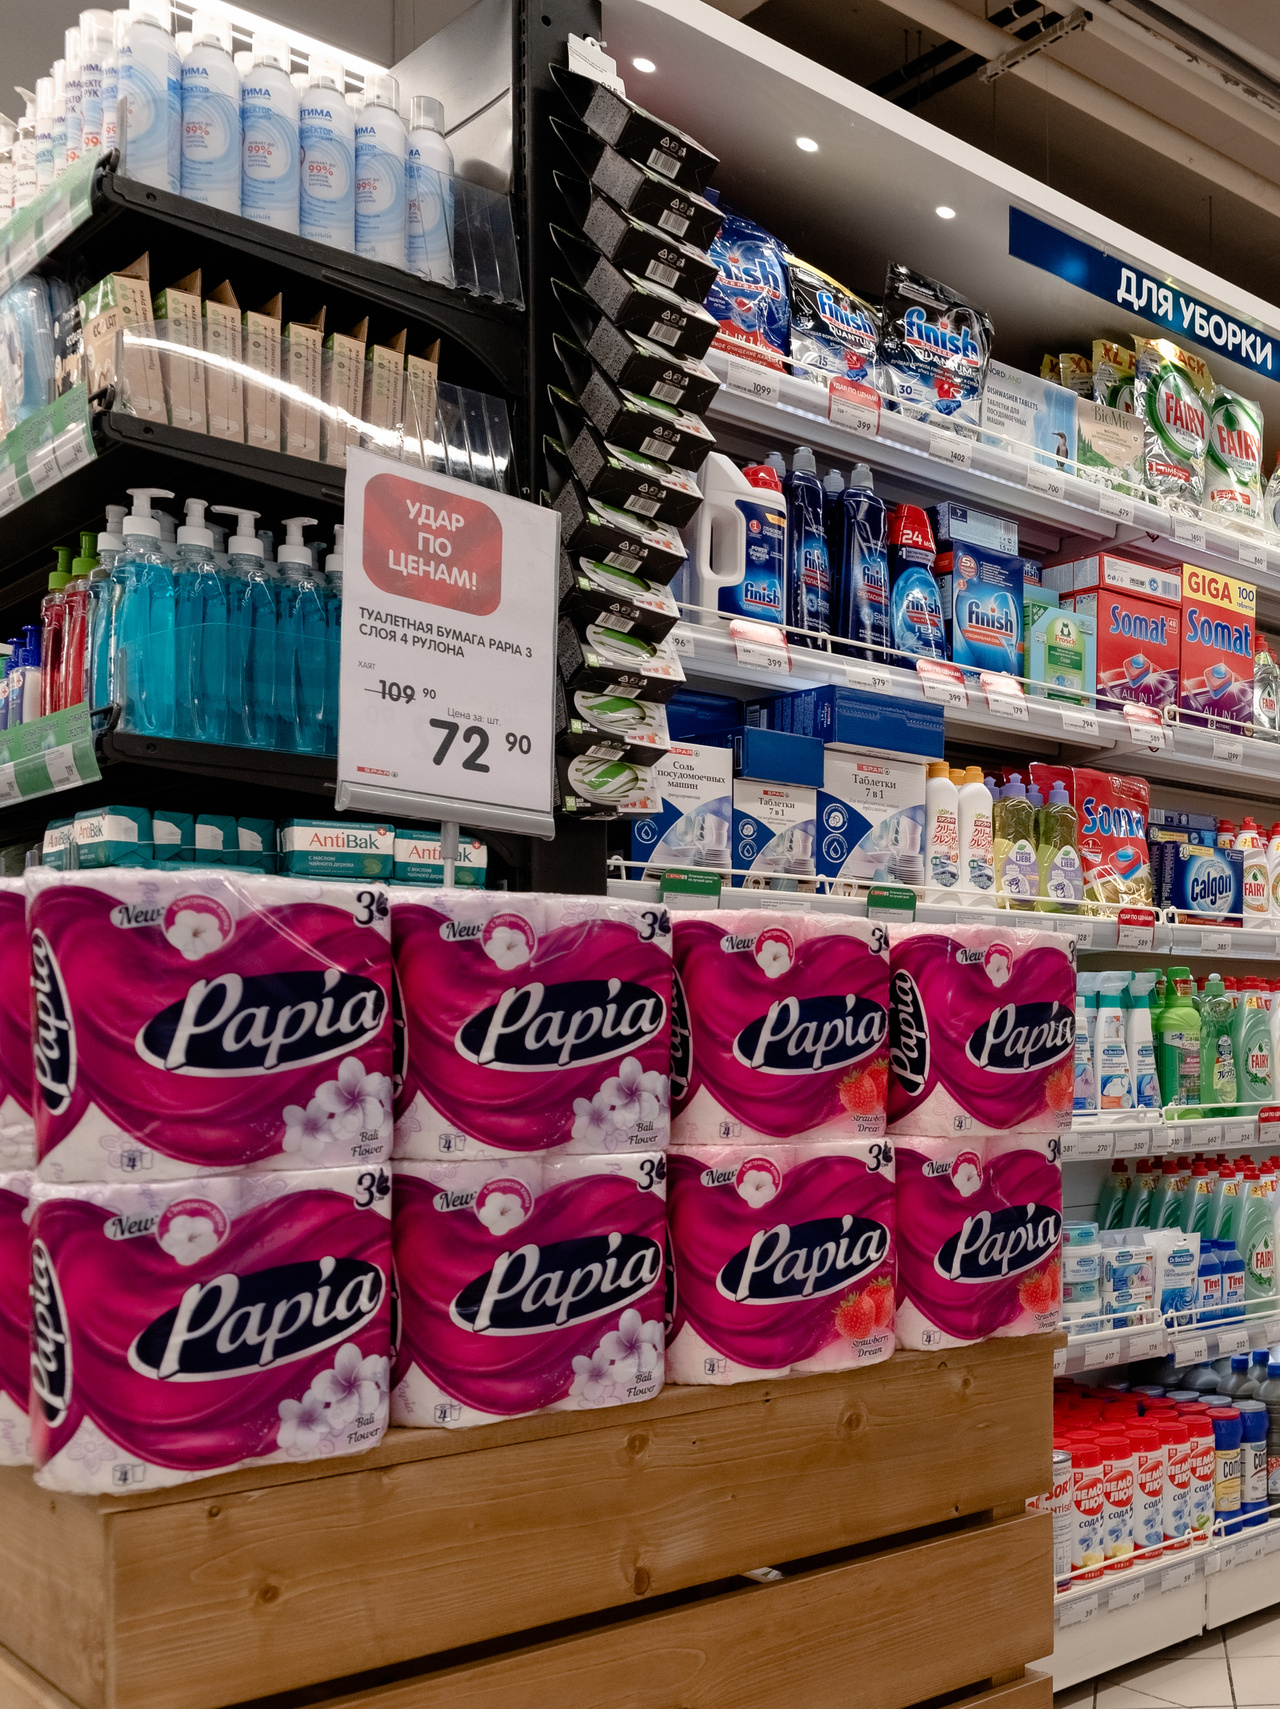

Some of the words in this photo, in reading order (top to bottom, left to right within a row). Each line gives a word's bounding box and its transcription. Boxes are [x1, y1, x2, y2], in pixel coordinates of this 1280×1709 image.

[308, 164, 334, 176] 99%
[816, 289, 875, 336] finish
[1117, 268, 1173, 321] ДЛЯ
[1179, 297, 1273, 371] УБОРКИ
[904, 305, 980, 366] finish
[753, 382, 772, 396] 1099
[832, 381, 847, 393] УДАР
[847, 386, 857, 395] ПО
[898, 383, 913, 396] 30
[986, 385, 1021, 405] DISHWASHER
[1021, 396, 1039, 411] TABLETS
[1092, 404, 1132, 432] BioMio
[1165, 391, 1206, 440] FAIRY
[856, 420, 871, 432] 399
[950, 450, 966, 463] 1402
[1048, 484, 1059, 494] 700
[406, 499, 465, 532] УДАР
[1118, 508, 1129, 518] 479
[417, 532, 451, 557] ПО
[902, 529, 923, 546] 24
[388, 549, 477, 591] ЦЕНАМ!
[804, 549, 829, 577] finish
[862, 565, 888, 589] finish
[744, 580, 781, 606] finish
[1188, 571, 1233, 604] GIGA
[1238, 586, 1255, 603] 100
[967, 600, 1015, 636] finish
[1109, 604, 1168, 646] Somat
[359, 606, 434, 635] ТУАЛЕТНАЯ
[436, 626, 486, 648] БУМАГА
[525, 647, 533, 658] 3
[359, 624, 397, 642] СЛОЯ
[400, 634, 409, 646] 4
[412, 636, 465, 658] РУЛОНА
[1054, 632, 1077, 647] Frosch
[1185, 608, 1252, 658] Somat
[767, 658, 782, 668] 399
[378, 679, 416, 704] 109
[422, 687, 437, 700] 90
[872, 677, 886, 687] 379
[948, 693, 961, 702] 399
[1121, 689, 1137, 700] ALL
[447, 707, 471, 721] Цена
[472, 714, 485, 723] за:
[486, 715, 501, 726] шт.
[1081, 720, 1094, 729] 794
[429, 717, 491, 774] 72
[504, 732, 532, 755] 90
[362, 767, 391, 777] SPAR
[657, 768, 726, 785] посудомоечных
[672, 761, 695, 773] Соль
[862, 765, 884, 774] SPAR
[667, 779, 699, 791] машин
[852, 773, 897, 790] Таблетки
[865, 787, 871, 797] 7
[879, 789, 884, 799] 1
[758, 797, 795, 809] Таблетки
[309, 831, 380, 850] AntiBak
[408, 844, 473, 863] Antiak
[1190, 871, 1232, 906] Calgon
[1244, 881, 1266, 898] FAIRY
[117, 904, 163, 926] New
[355, 890, 375, 926] 3
[446, 920, 483, 940] New
[639, 910, 655, 941] 3
[725, 934, 756, 952] New
[869, 926, 884, 955] 3
[960, 948, 985, 964] New
[164, 967, 381, 1071] Papia
[477, 977, 662, 1067] Papia
[750, 992, 888, 1070] Papia
[979, 1001, 1074, 1070] Papia
[1251, 1053, 1269, 1070] FAIRY
[359, 1128, 379, 1143] Bali
[636, 1120, 654, 1133] Bali
[627, 1133, 659, 1146] Flower
[350, 1142, 384, 1158] Flower
[866, 1143, 884, 1173] 3
[1046, 1138, 1058, 1164] 3
[638, 1158, 655, 1191] 3
[705, 1168, 737, 1186] New
[926, 1160, 951, 1177] New
[356, 1173, 375, 1209] 3
[438, 1189, 475, 1210] New
[112, 1216, 154, 1238] New
[950, 1202, 1061, 1282] Papia
[735, 1214, 887, 1302] Papia
[472, 1231, 659, 1333] Papia
[158, 1255, 379, 1380] Papia
[634, 1371, 653, 1384] Bali
[626, 1383, 657, 1398] Flower
[355, 1412, 375, 1429] Bali
[347, 1425, 381, 1445] Flower
[1079, 1518, 1100, 1529] СОДА
[1108, 1509, 1129, 1520] СОДА
